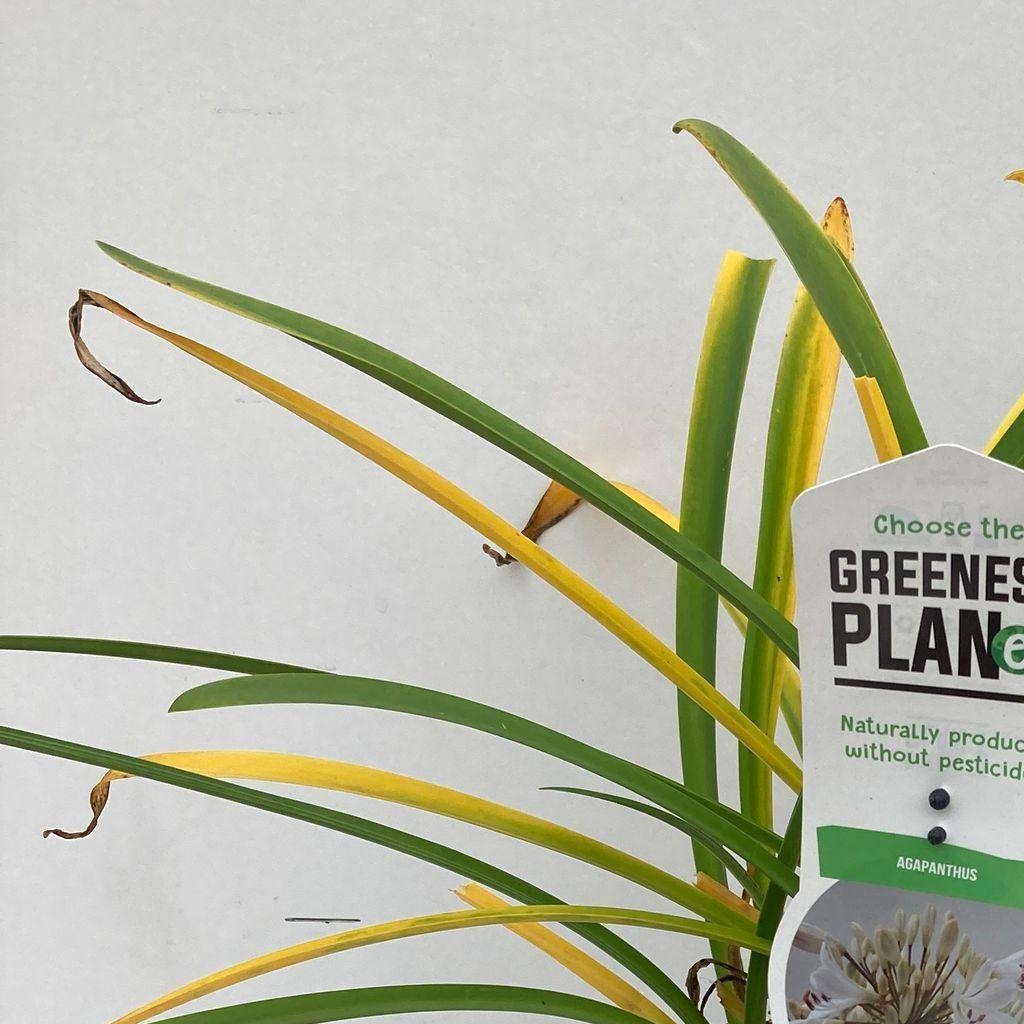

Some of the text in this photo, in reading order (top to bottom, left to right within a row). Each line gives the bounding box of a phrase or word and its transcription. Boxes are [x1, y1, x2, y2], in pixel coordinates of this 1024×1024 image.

[874, 514, 1024, 540] Choose the
[840, 714, 940, 745] Naturally
[844, 743, 930, 768] without
[896, 856, 979, 882] AGAPANTHUS
